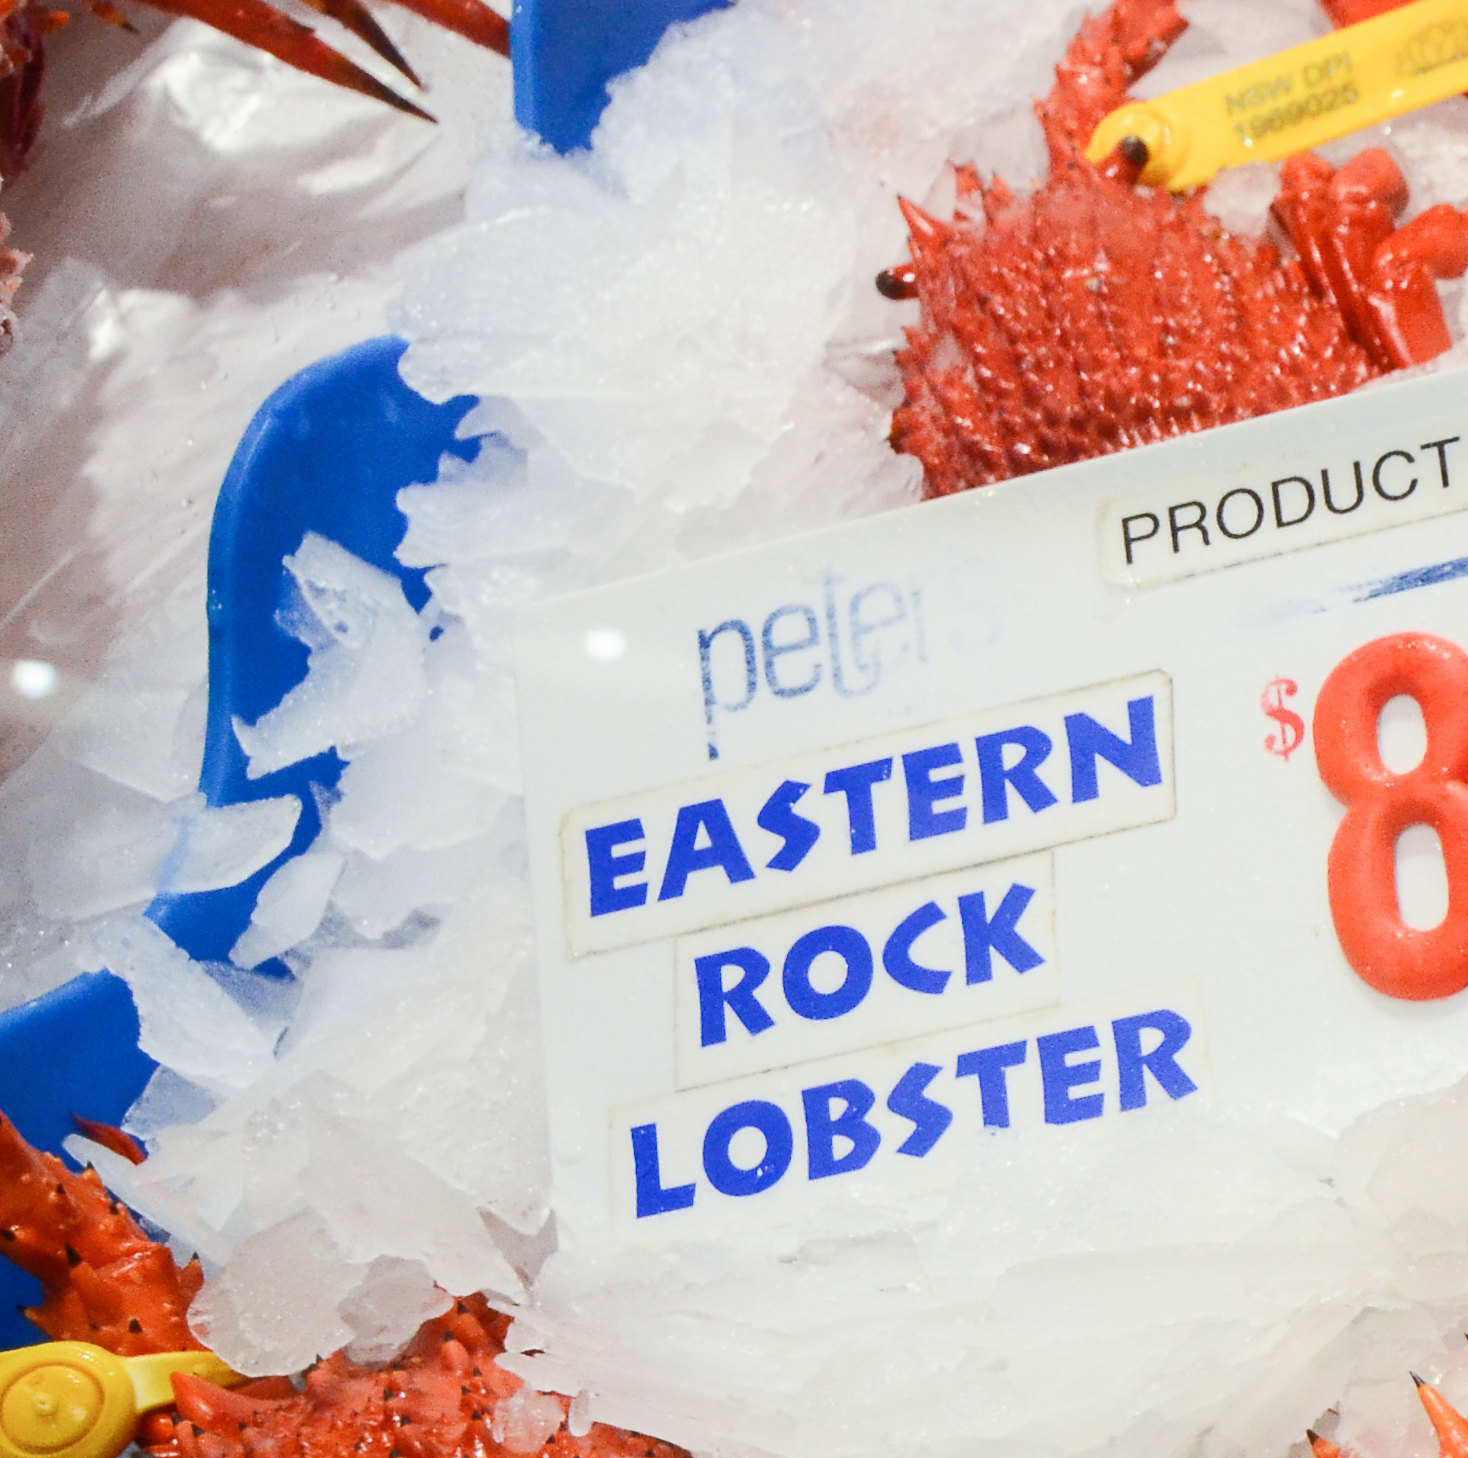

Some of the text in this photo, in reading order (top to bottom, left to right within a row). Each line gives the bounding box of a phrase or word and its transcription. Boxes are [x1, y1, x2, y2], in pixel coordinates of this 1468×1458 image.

[1120, 436, 1461, 565] PRODUCT
[695, 556, 1002, 763] peter
[585, 696, 1163, 917] EASTERN
[694, 882, 1046, 1047] ROCK
[630, 1008, 1198, 1219] LOBSTER
